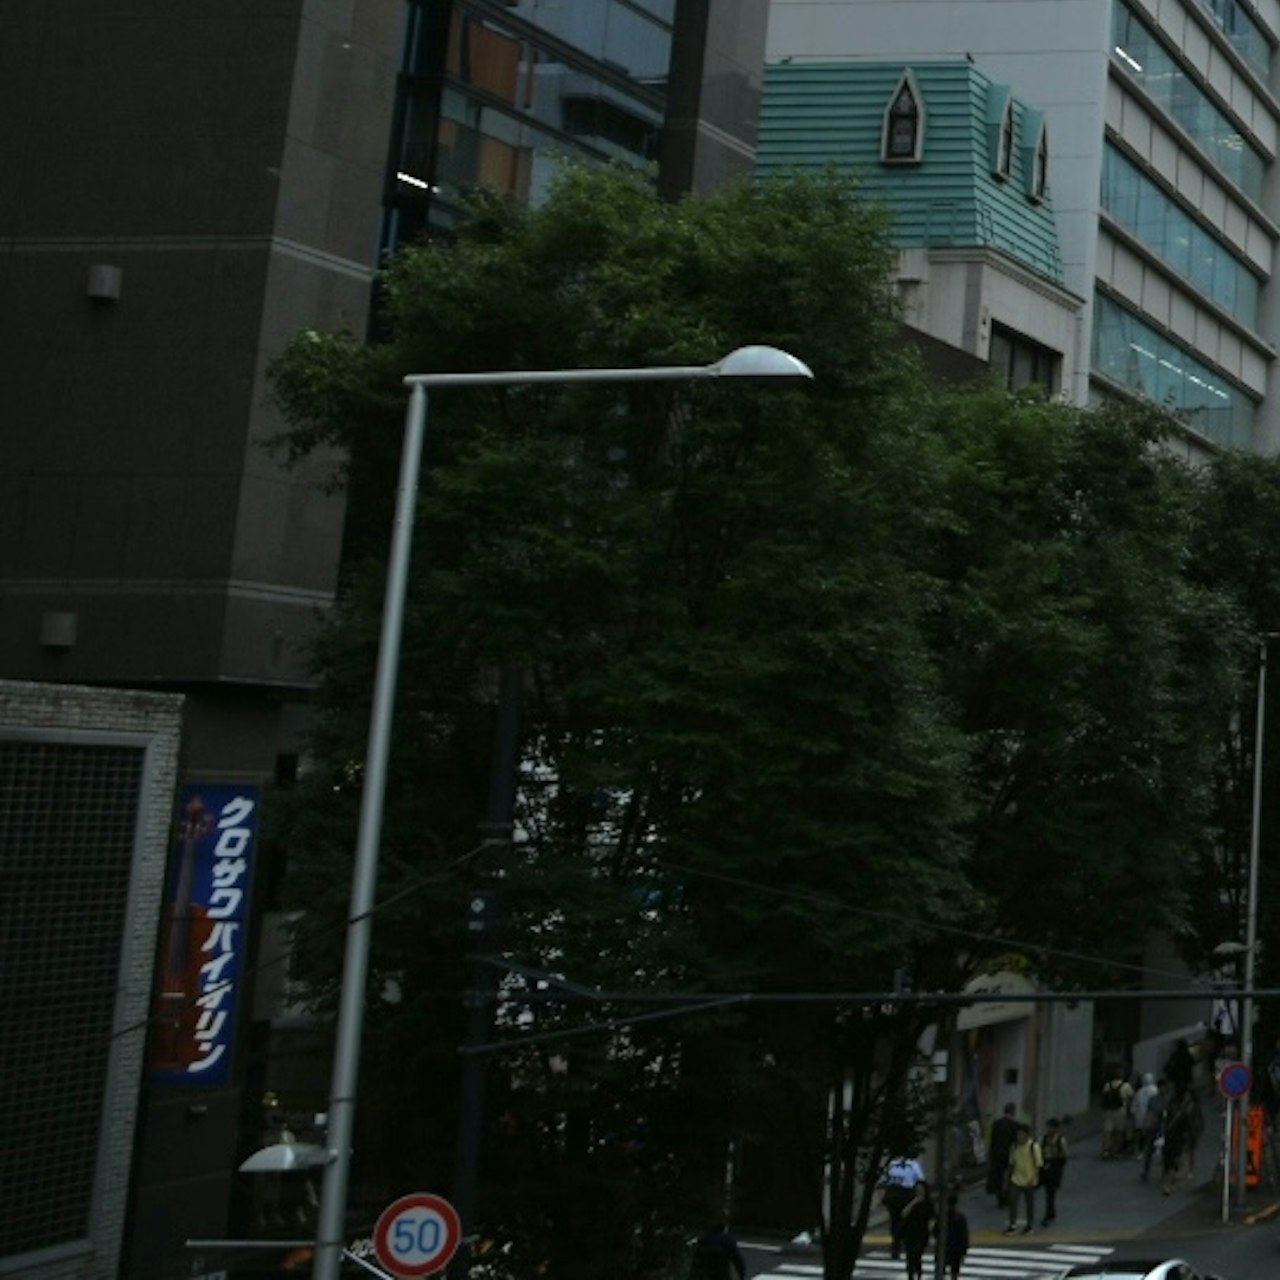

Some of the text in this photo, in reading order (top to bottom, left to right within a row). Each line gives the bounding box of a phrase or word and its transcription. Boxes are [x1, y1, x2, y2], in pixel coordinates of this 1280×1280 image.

[187, 795, 256, 1073] クロサワバイオリン
[394, 1219, 440, 1254] 50
